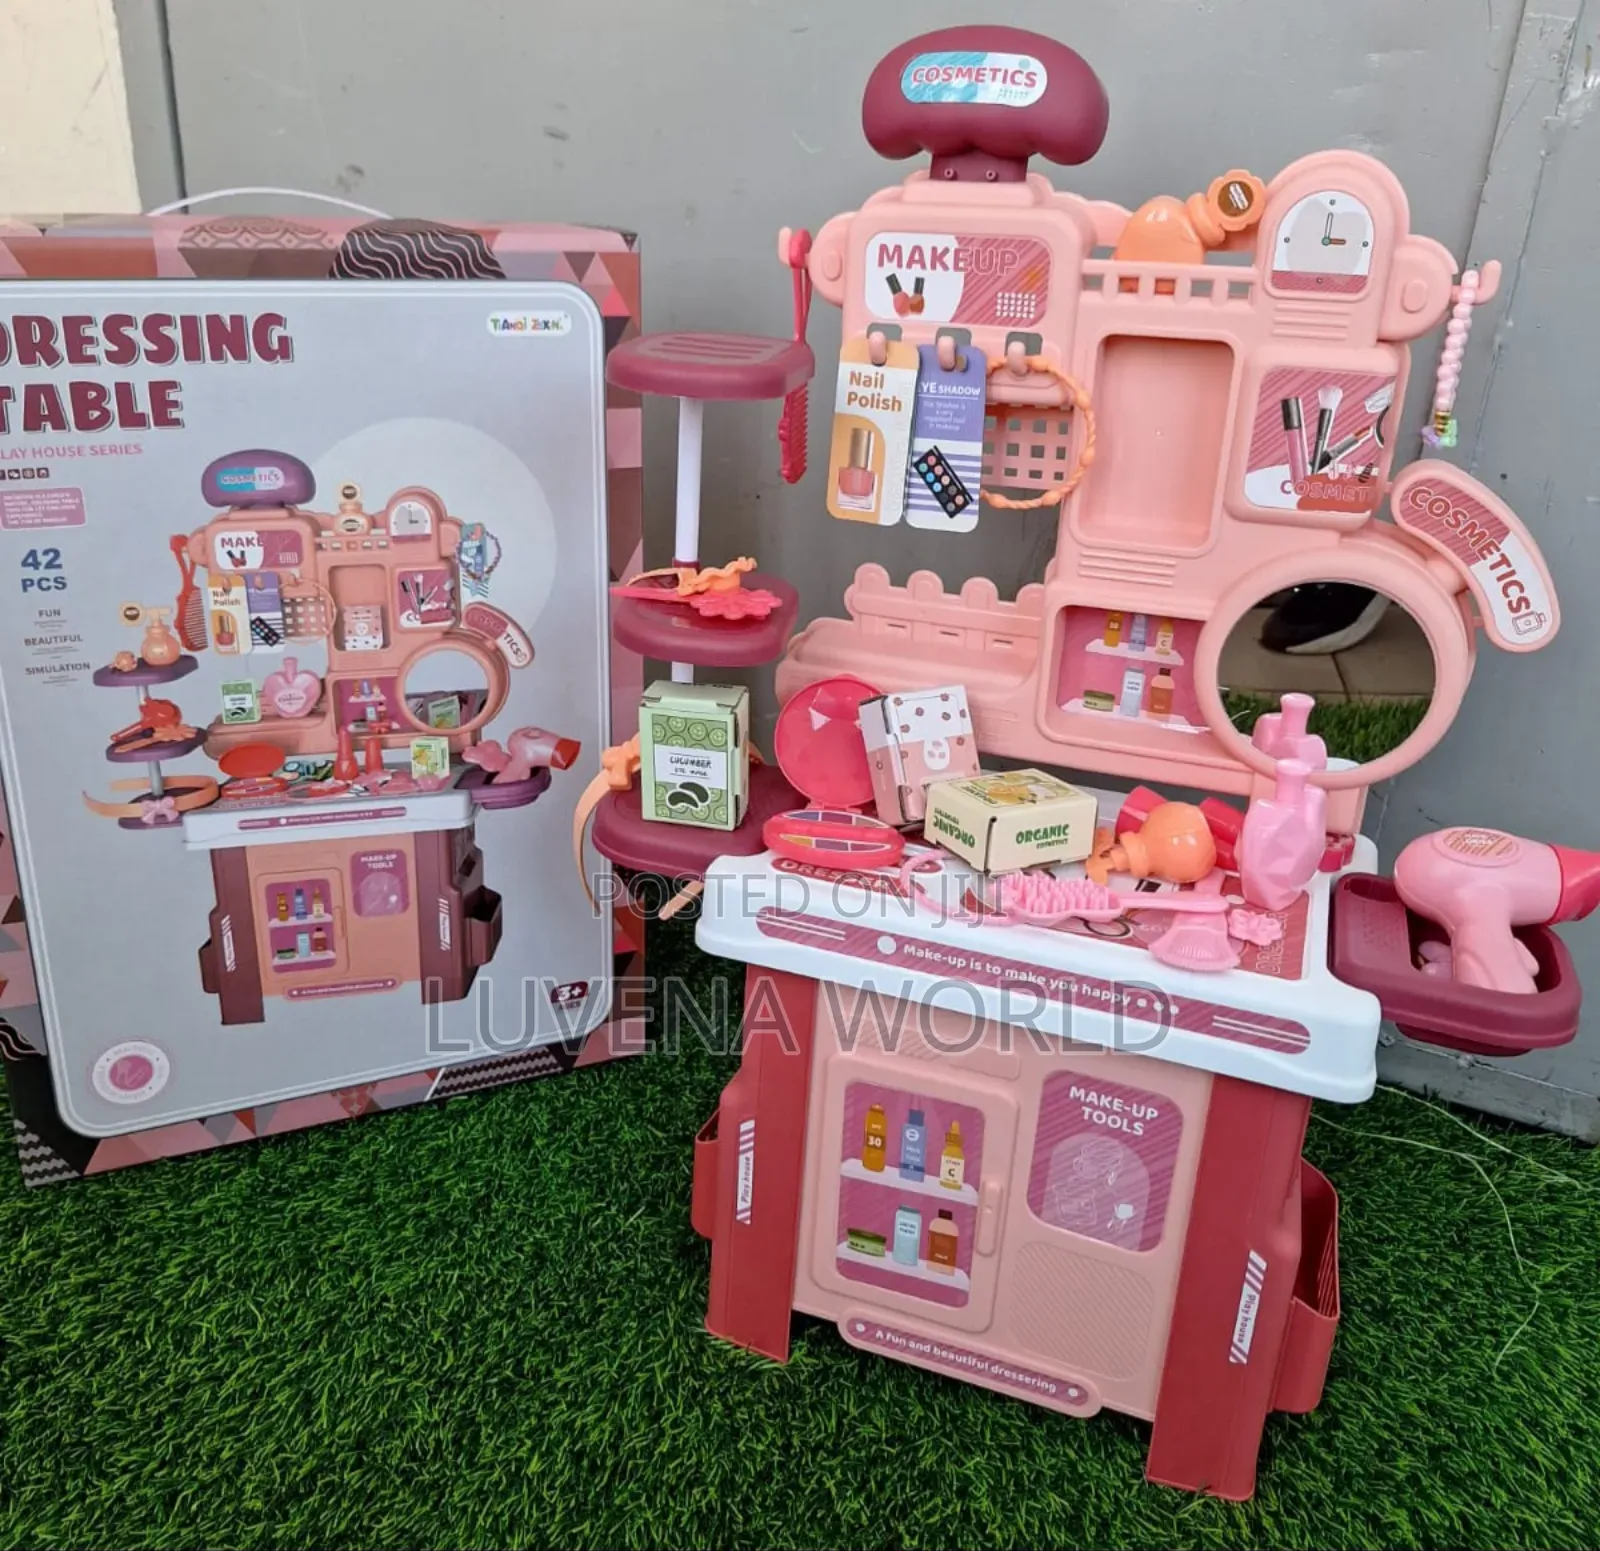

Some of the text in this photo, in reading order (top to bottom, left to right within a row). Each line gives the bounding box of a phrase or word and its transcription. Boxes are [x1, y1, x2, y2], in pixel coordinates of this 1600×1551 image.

[912, 66, 1038, 88] COSMETICS
[877, 243, 1020, 277] MAKEUP
[0, 312, 294, 369] RESSING
[849, 370, 885, 390] Nail
[917, 381, 981, 397] YE SHADOW
[847, 391, 903, 413] Polish
[32, 445, 86, 460] HOUSE
[89, 442, 144, 458] SERIES
[20, 547, 64, 572] 42
[1409, 486, 1531, 615] COSMETICS
[20, 575, 69, 593] PCS
[37, 608, 62, 618] FUN
[23, 634, 85, 646] BEAUTIFUL
[25, 662, 92, 676] SIMULATION
[669, 755, 713, 769] CUCUMBER
[933, 814, 976, 848] ORGANIC
[1015, 823, 1070, 845] ORGANIC
[903, 943, 1132, 1006] Make-up is to make you happy
[1068, 1085, 1159, 1121] MAKE-UP
[1081, 1105, 1145, 1137] TOOLS
[875, 1329, 1057, 1394] A fun and beautiful dressering
